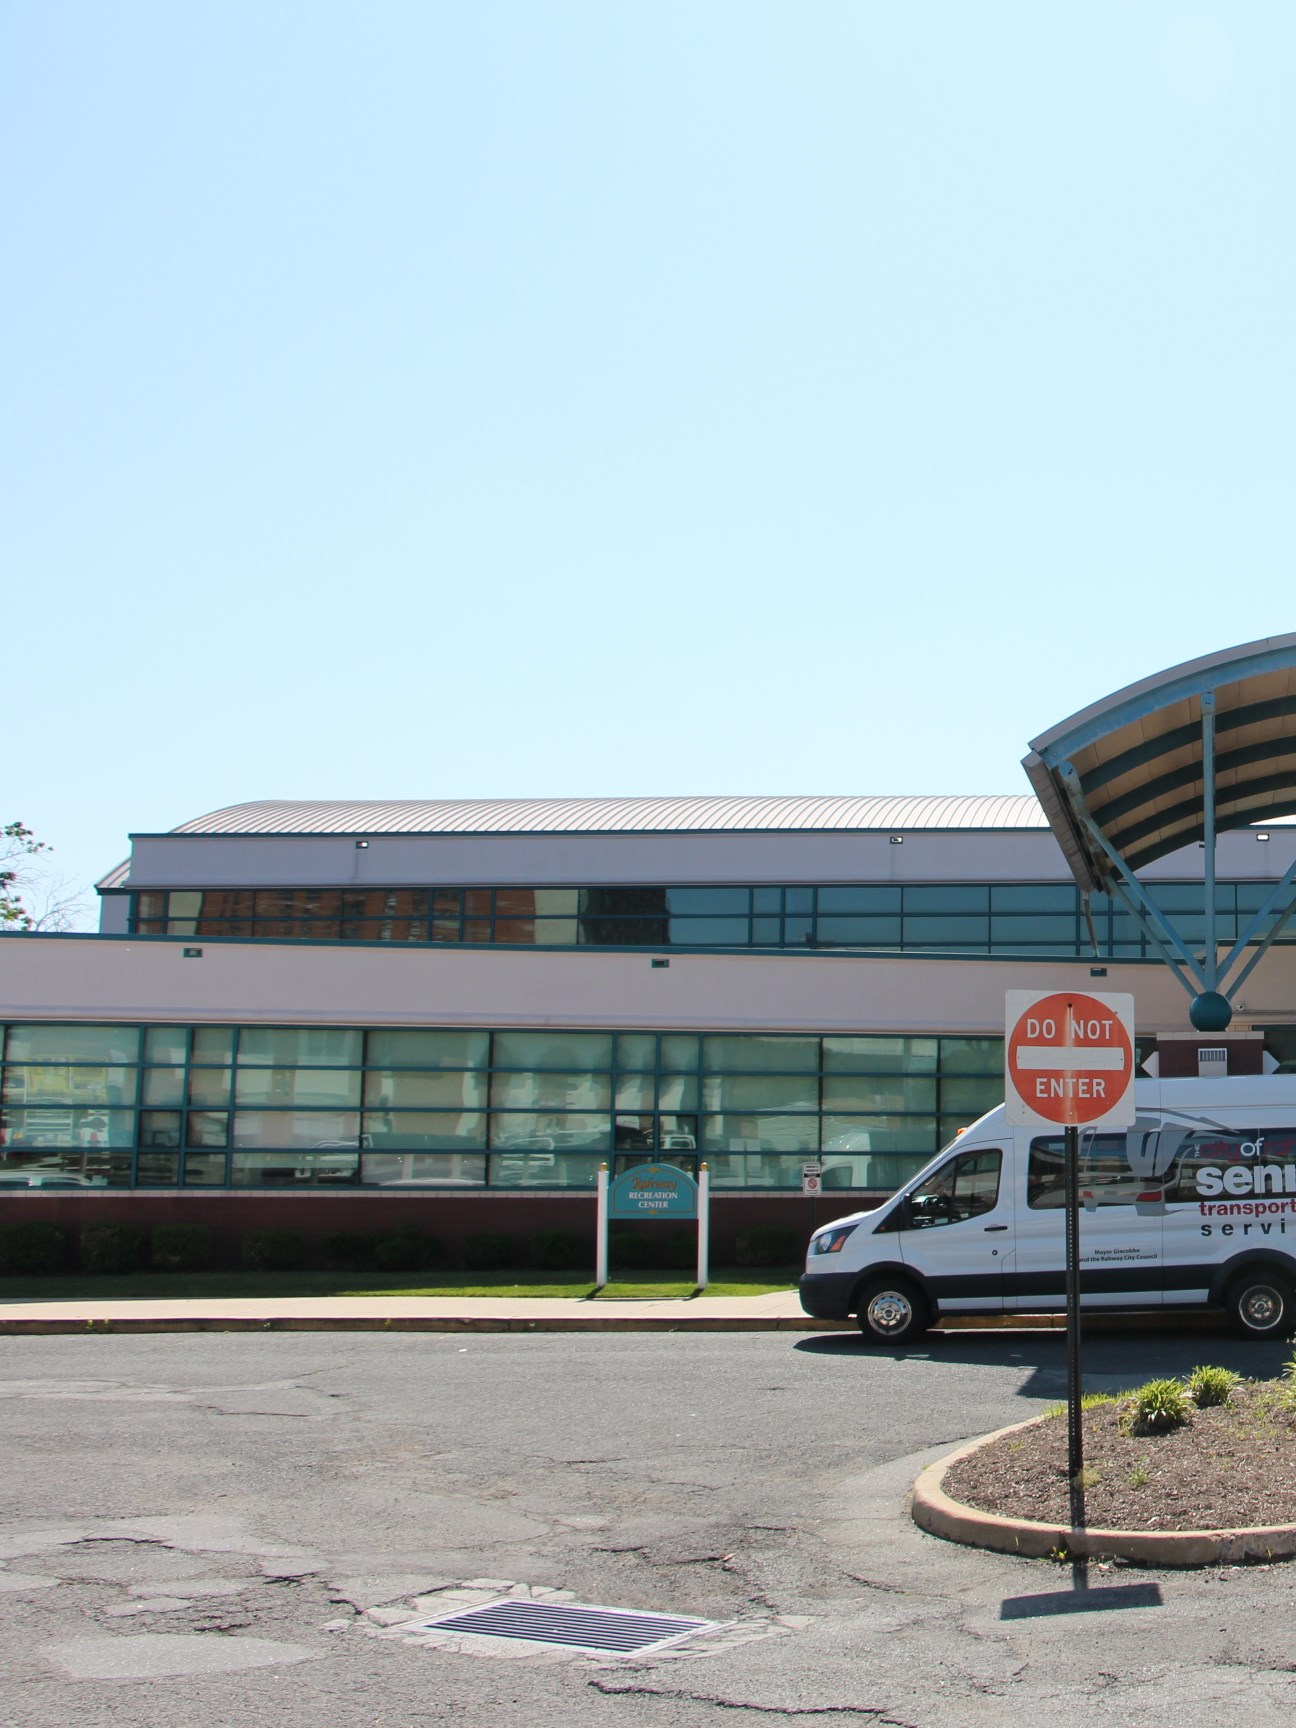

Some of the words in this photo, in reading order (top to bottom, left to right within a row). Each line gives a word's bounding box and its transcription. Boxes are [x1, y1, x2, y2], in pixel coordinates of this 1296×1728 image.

[1026, 1019, 1056, 1039] DO
[1071, 1020, 1113, 1040] NOT
[1036, 1078, 1106, 1098] ENTER
[1240, 1137, 1265, 1156] of
[629, 1191, 678, 1199] RECREATION
[638, 1200, 669, 1208] CENTER
[1094, 1248, 1112, 1256] Mayor
[1101, 1255, 1123, 1263] Rahway
